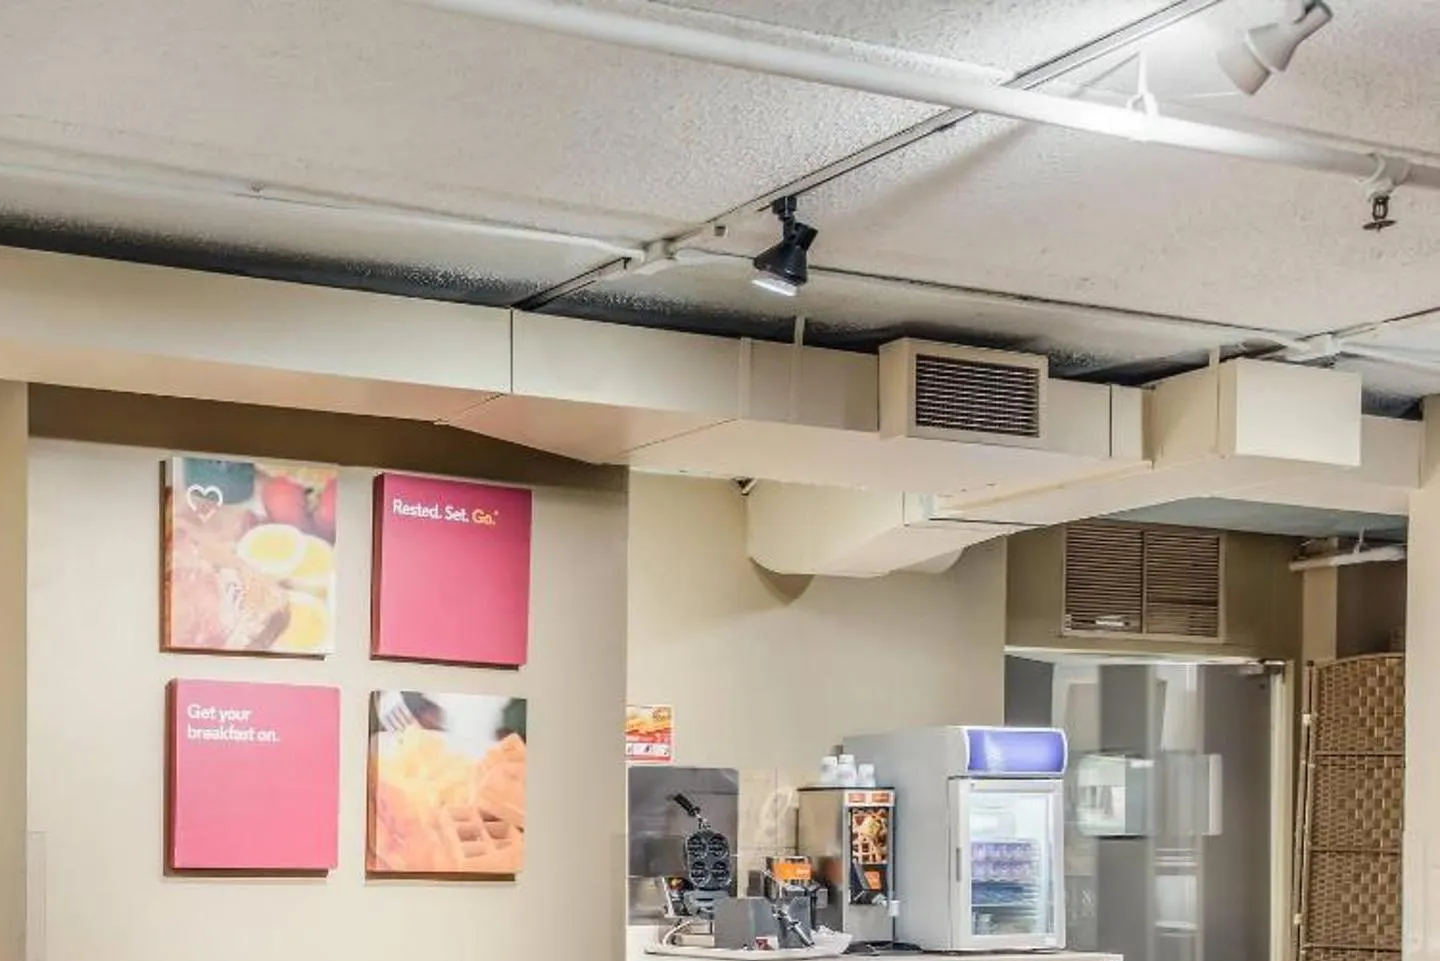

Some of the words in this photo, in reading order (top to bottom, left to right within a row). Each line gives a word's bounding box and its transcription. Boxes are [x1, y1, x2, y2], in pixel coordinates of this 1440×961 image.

[393, 498, 442, 520] Rested.
[445, 506, 469, 523] Set.
[187, 704, 216, 720] Get
[219, 709, 252, 724] your
[187, 724, 255, 741] breakfast
[257, 730, 280, 742] on.
